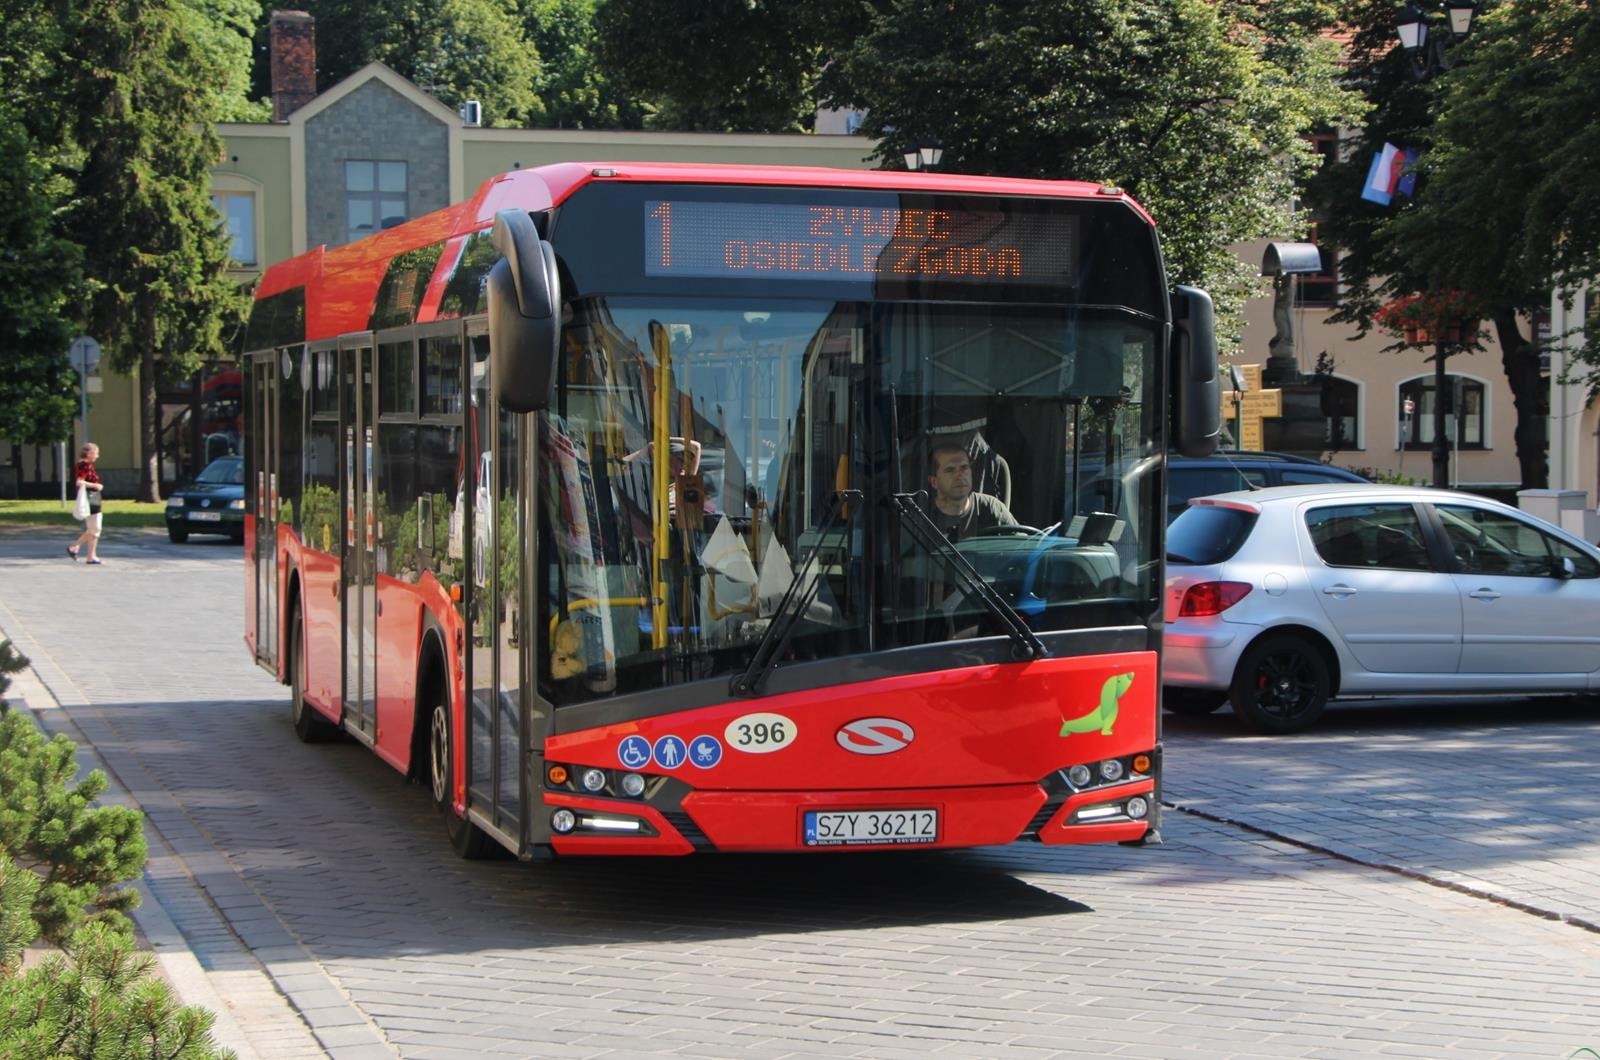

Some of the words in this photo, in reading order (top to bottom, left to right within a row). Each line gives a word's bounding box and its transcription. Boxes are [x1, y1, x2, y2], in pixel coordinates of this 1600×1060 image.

[650, 201, 672, 268] 1
[723, 239, 883, 273] OSIEDLE
[892, 245, 1023, 276] ZGODA
[737, 722, 785, 745] 396
[818, 814, 860, 837] SZY
[867, 813, 934, 836] 36212
